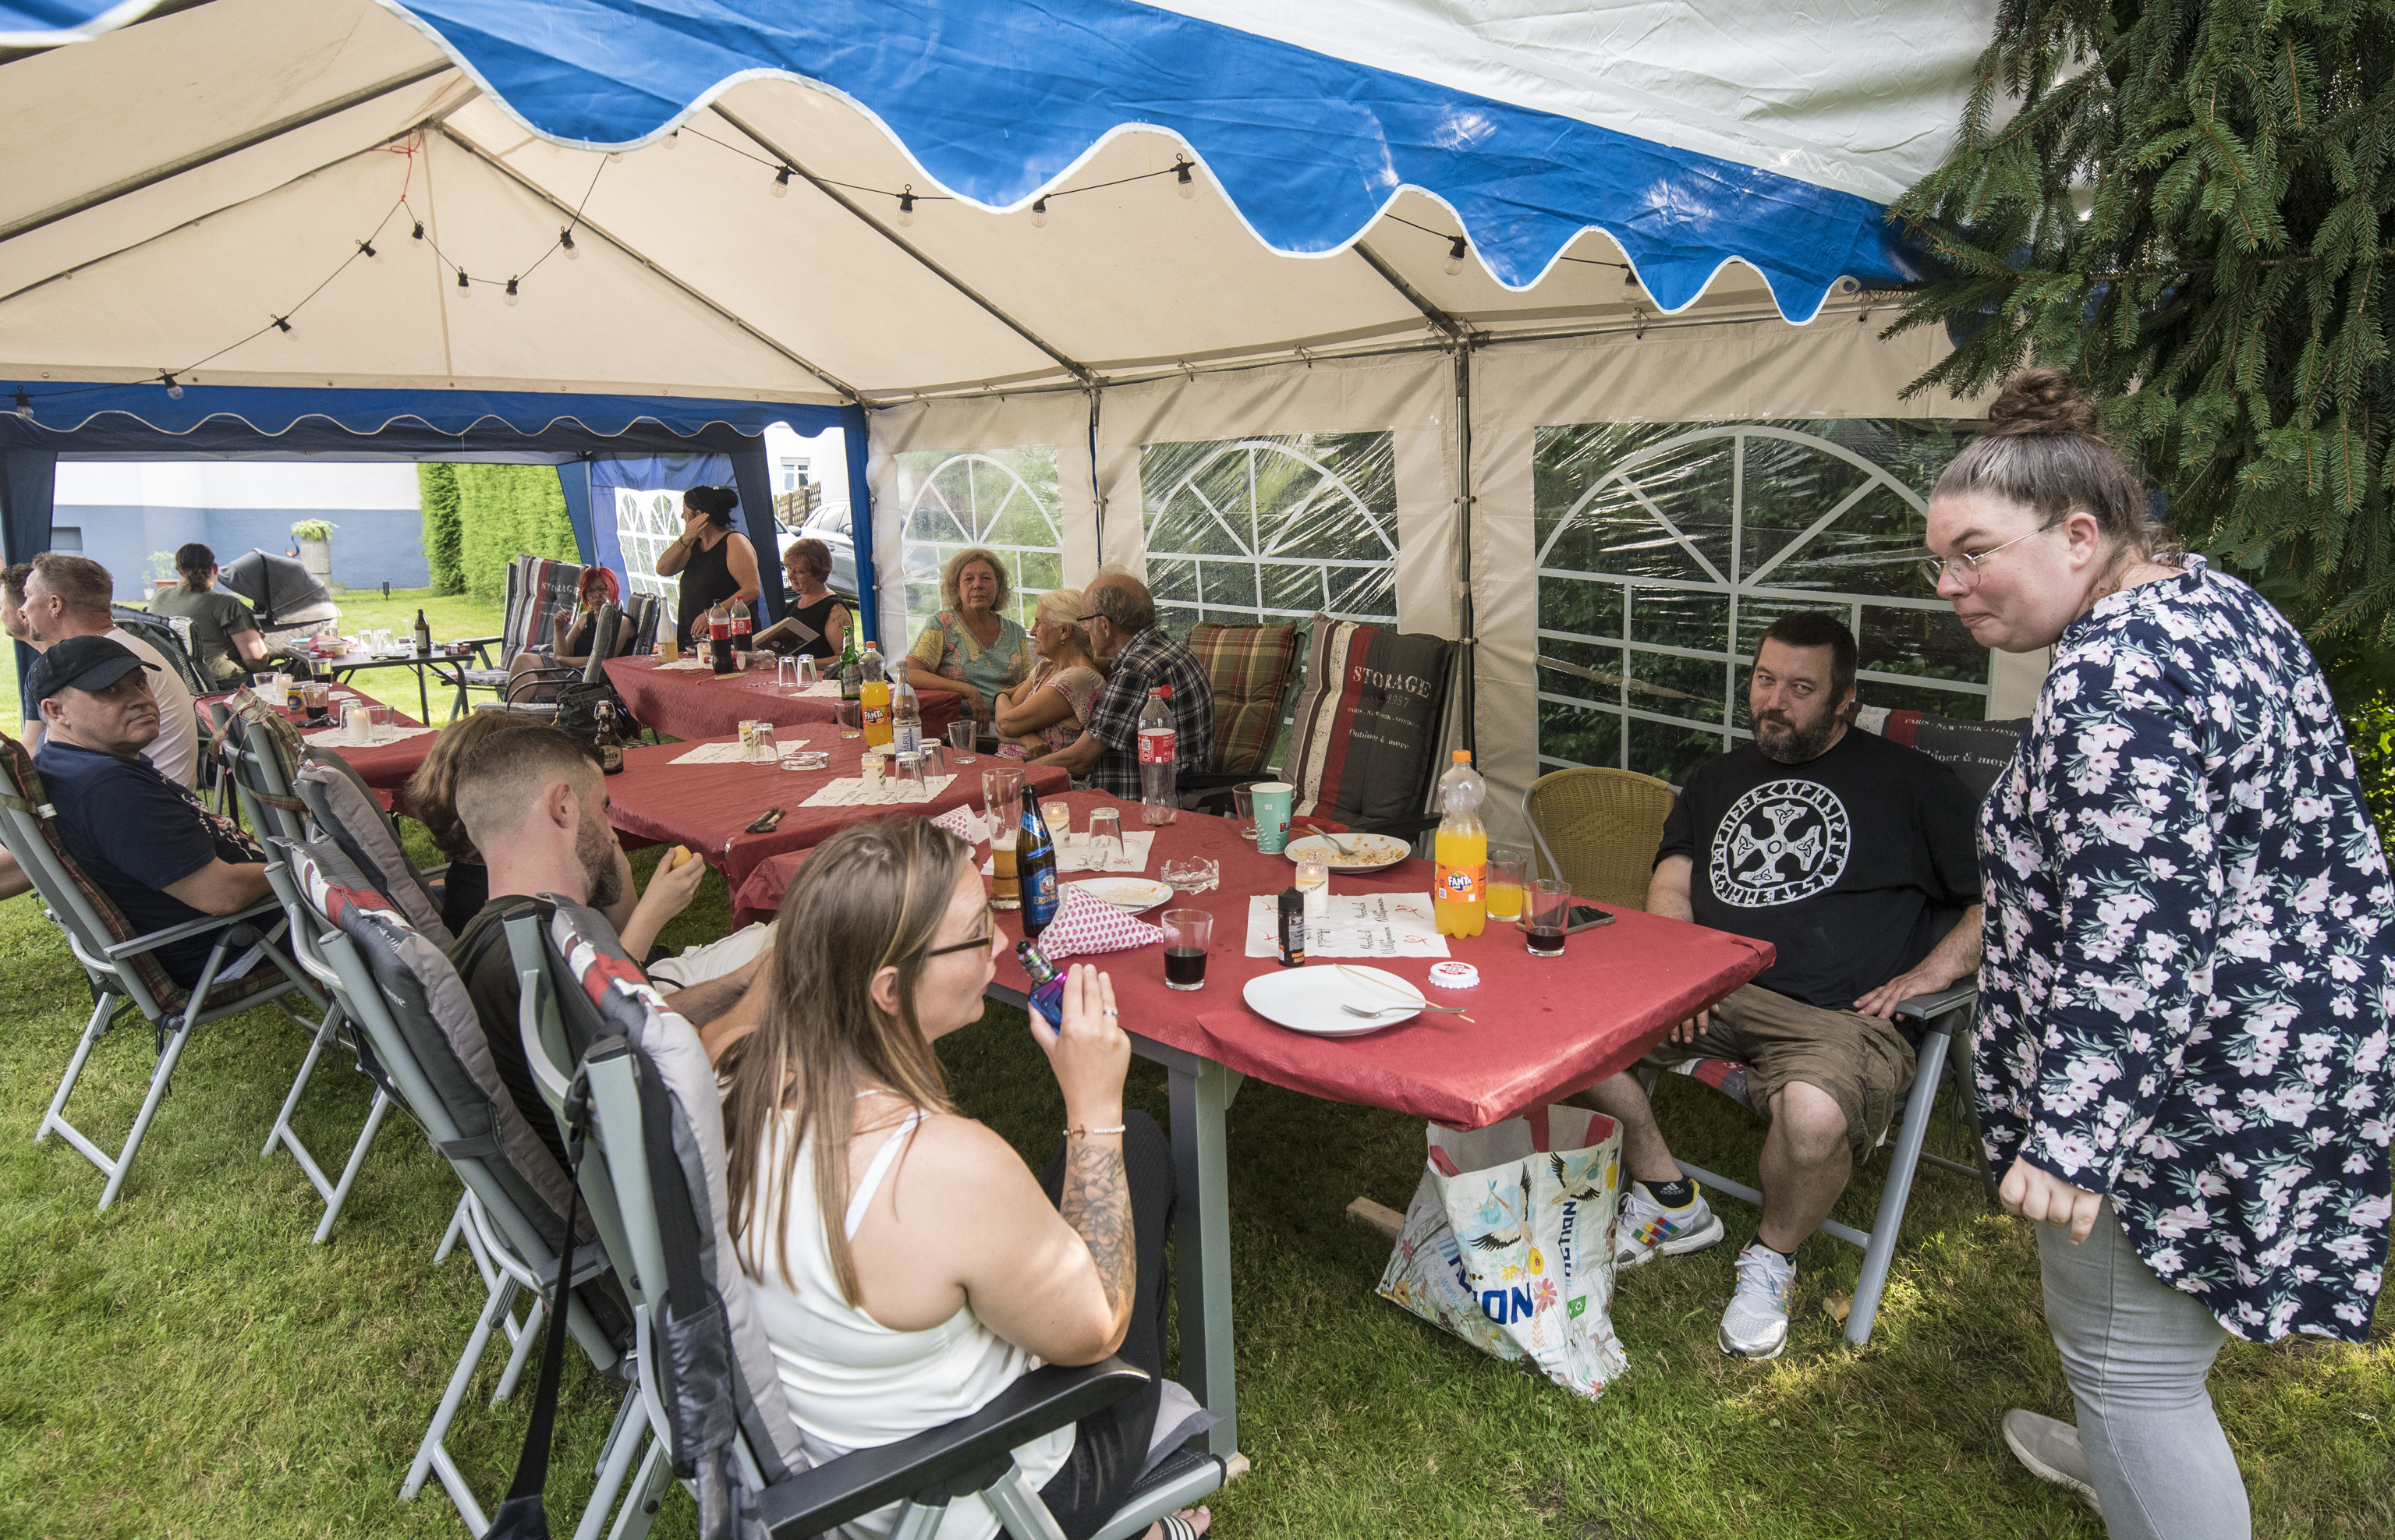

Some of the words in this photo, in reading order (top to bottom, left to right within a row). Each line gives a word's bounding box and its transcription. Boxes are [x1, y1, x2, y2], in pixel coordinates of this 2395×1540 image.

[1353, 666, 1432, 699] STORAGE
[864, 710, 884, 720] FANTA
[1936, 722, 1955, 731] NEW
[1349, 728, 1379, 741] Outdoor
[1388, 739, 1409, 750] more
[1447, 875, 1472, 887] FANTA
[1033, 894, 1060, 905] ERDIN
[1557, 1201, 1577, 1278] ACTION
